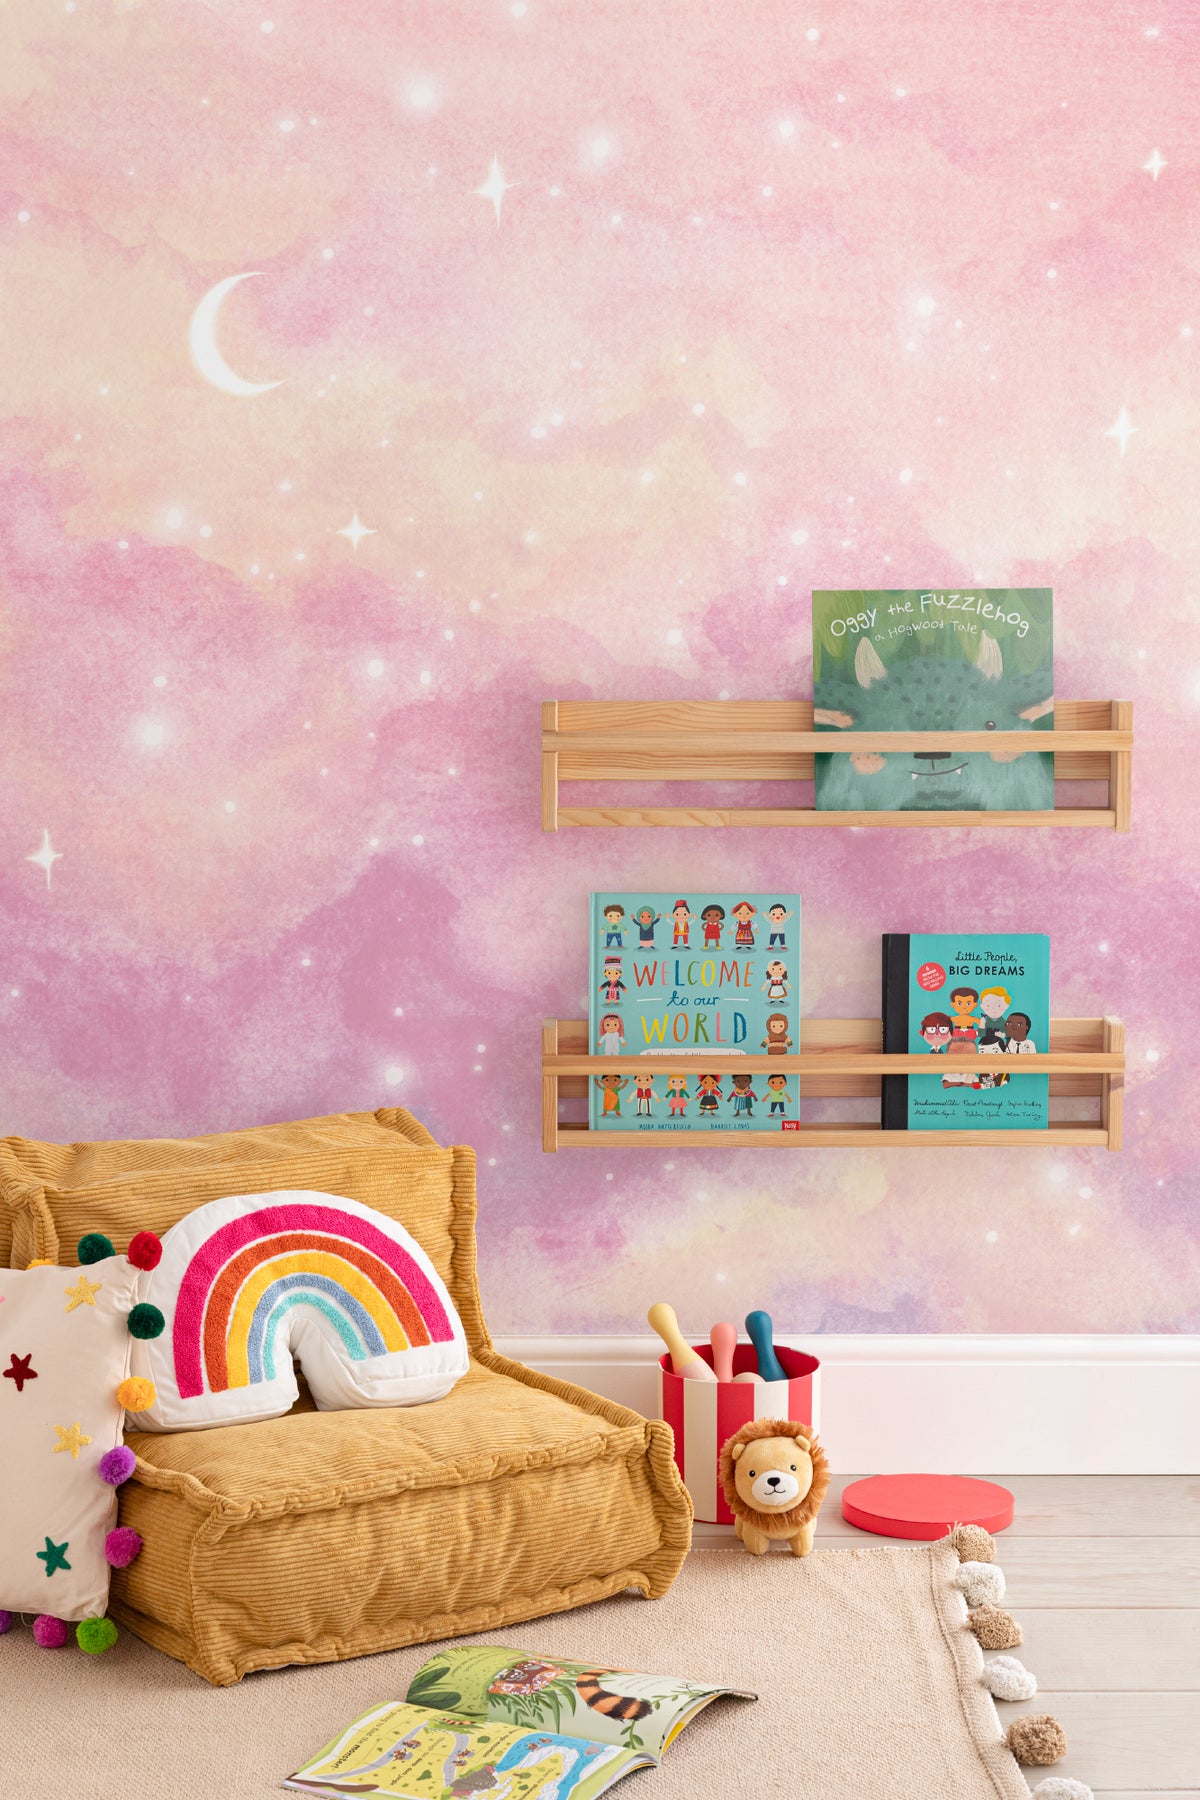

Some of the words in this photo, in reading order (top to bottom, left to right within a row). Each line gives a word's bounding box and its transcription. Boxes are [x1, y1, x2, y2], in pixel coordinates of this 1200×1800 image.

[830, 608, 877, 637] Oggy
[888, 601, 914, 616] the
[920, 593, 1030, 638] Fuzzlehog
[875, 634, 885, 642] a
[950, 620, 977, 635] Tale
[955, 951, 982, 962] Little
[984, 951, 1018, 966] People,
[633, 959, 756, 988] WELCOME
[949, 965, 970, 976] BIG
[975, 965, 1025, 976] DREAMS
[666, 990, 689, 1007] to
[693, 995, 720, 1007] our
[641, 1011, 748, 1044] WORLD
